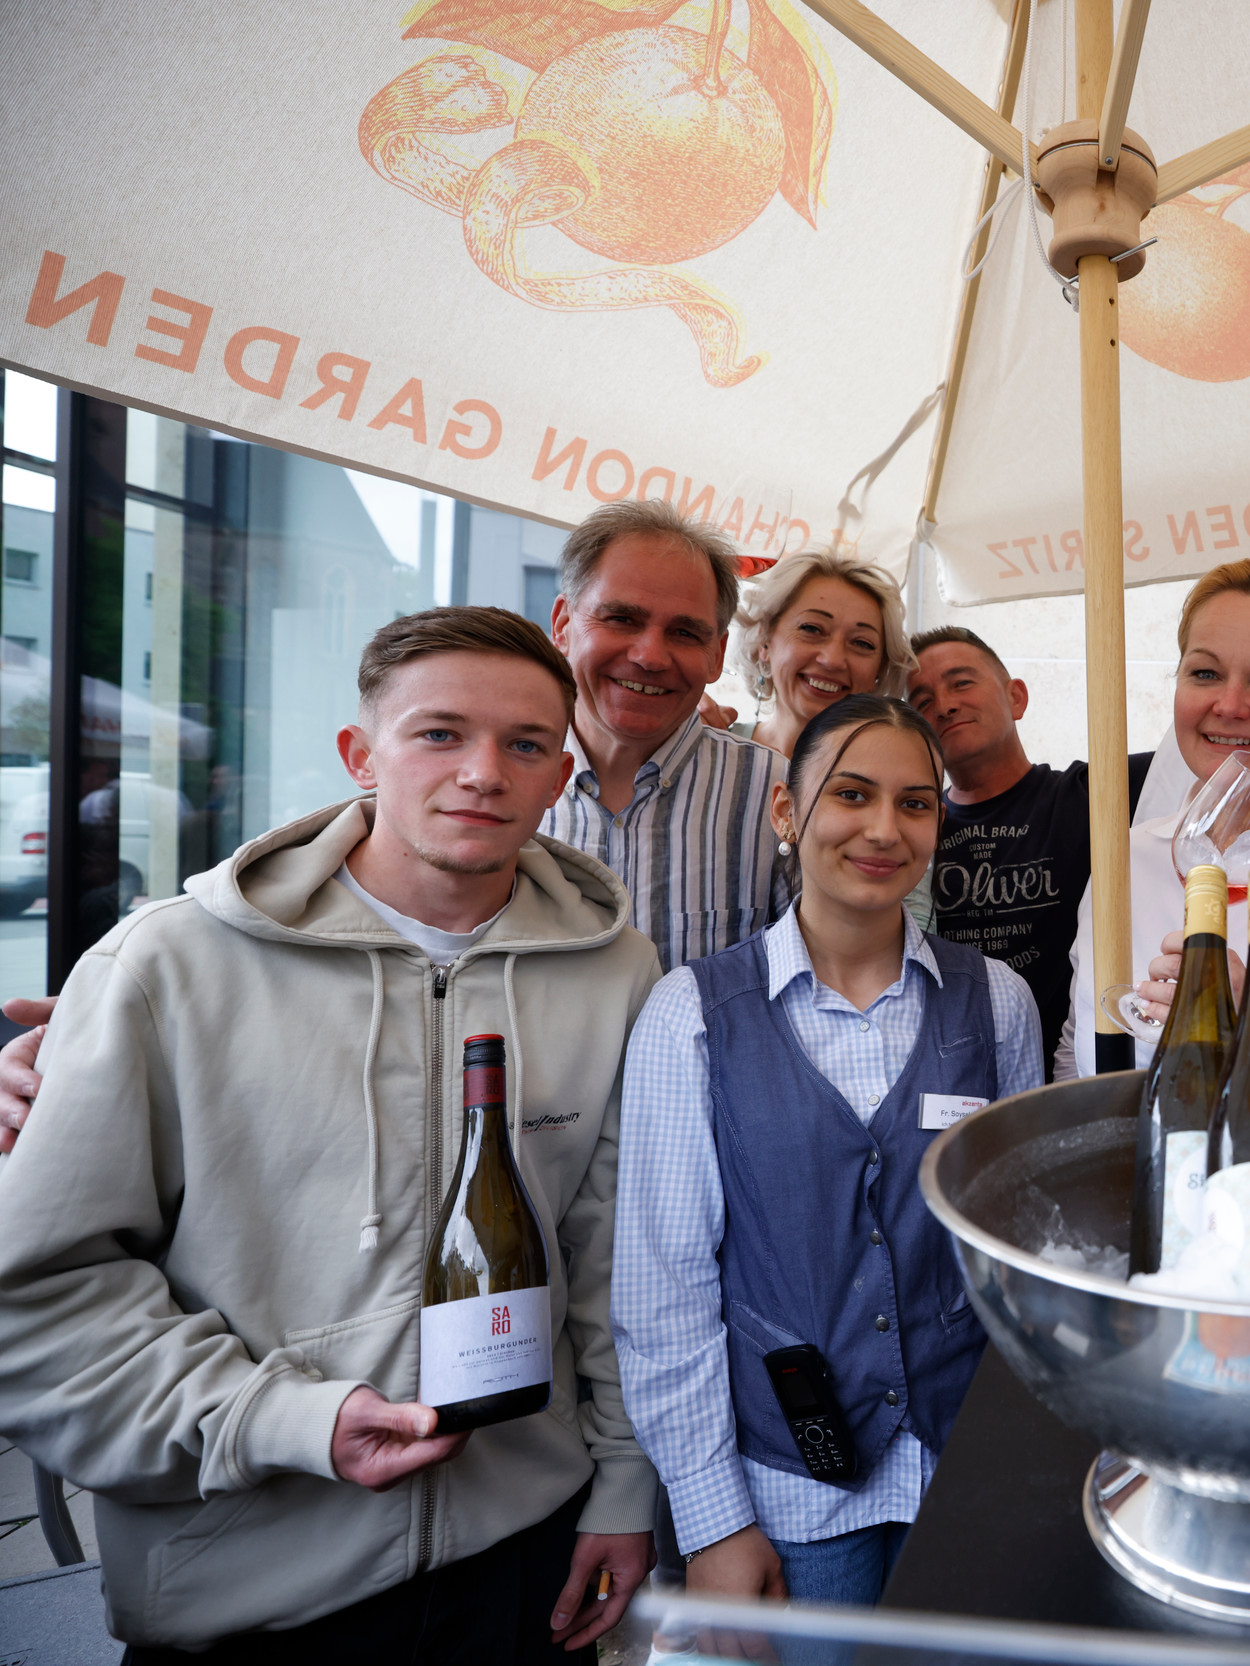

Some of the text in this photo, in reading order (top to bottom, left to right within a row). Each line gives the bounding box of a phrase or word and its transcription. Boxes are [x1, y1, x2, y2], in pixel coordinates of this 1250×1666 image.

[969, 842, 996, 852] CUSTOM
[973, 850, 992, 860] MADE
[936, 862, 1059, 911] Oliver
[983, 923, 1033, 939] COMPANY
[986, 939, 1009, 951] 1969
[1006, 946, 1040, 971] OODS
[491, 1305, 511, 1321] SA
[491, 1319, 511, 1336] RO
[458, 1337, 537, 1358] WEISSBURGUNDER
